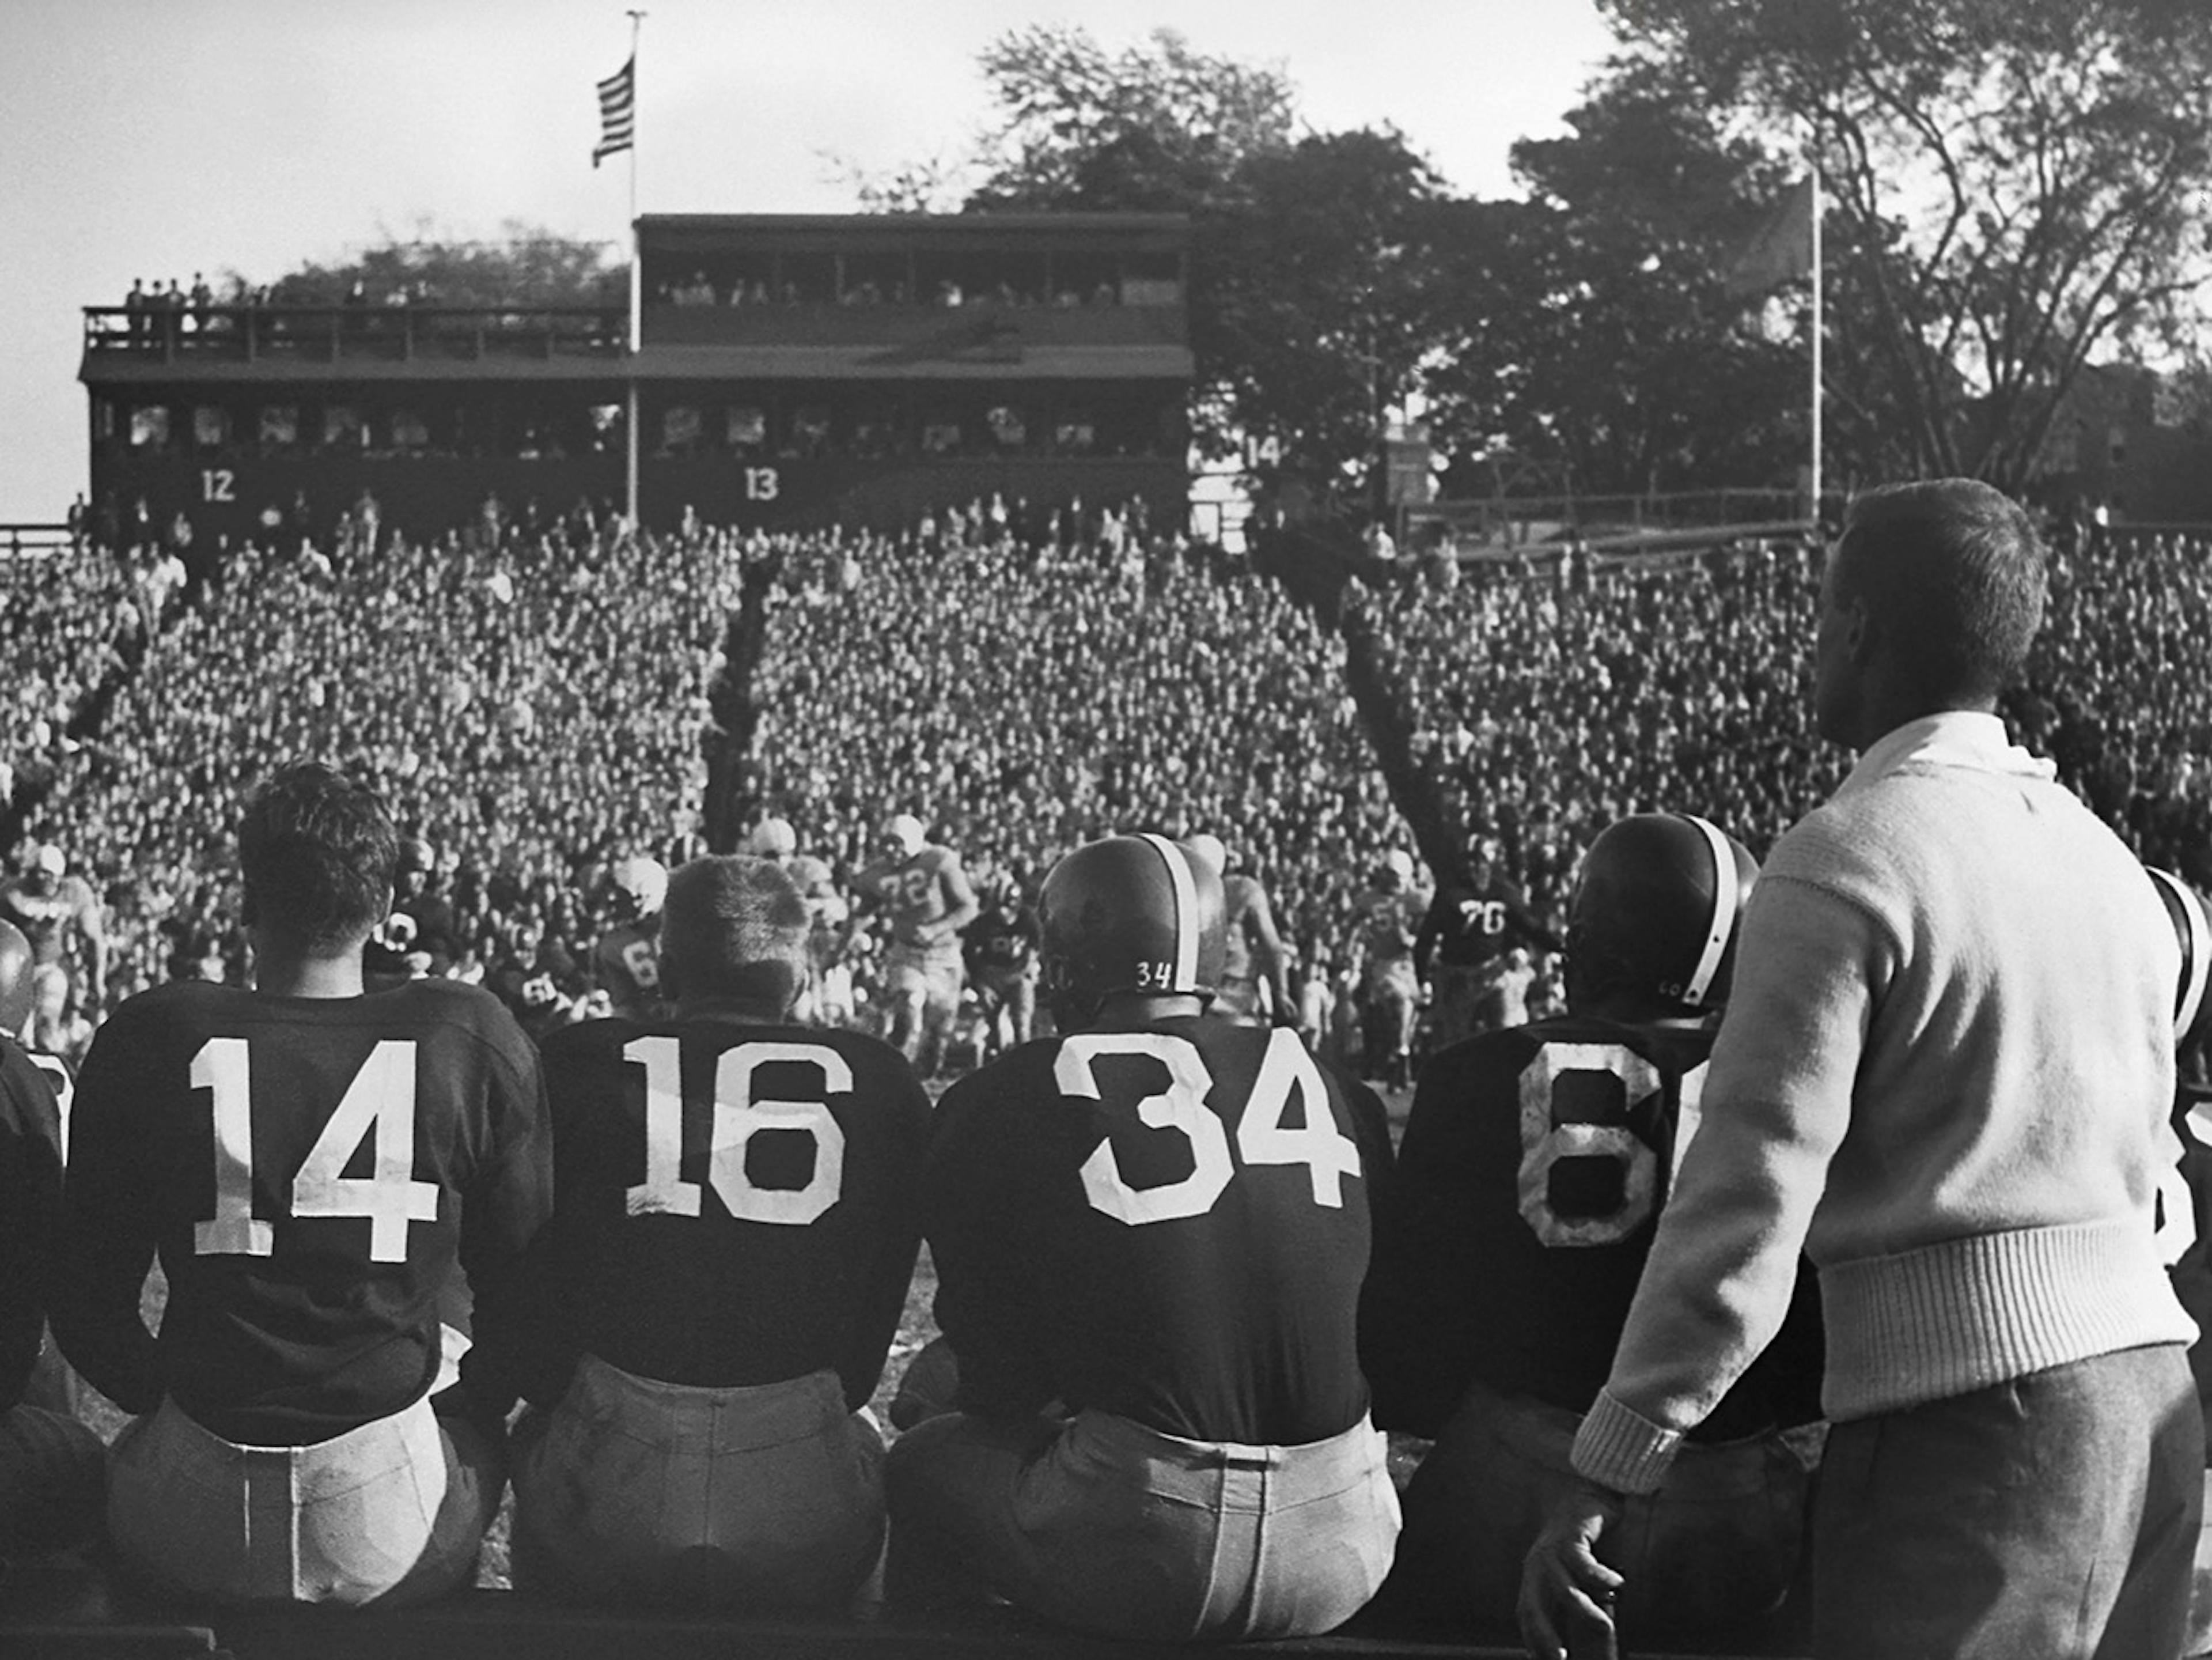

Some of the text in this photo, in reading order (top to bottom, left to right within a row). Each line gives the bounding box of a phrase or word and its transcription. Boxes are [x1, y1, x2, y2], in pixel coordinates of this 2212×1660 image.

[1247, 434, 1281, 468] 14
[202, 470, 236, 502] 12
[745, 467, 778, 501] 13
[1137, 961, 1172, 989] 34
[623, 1035, 854, 1225] 16
[1054, 1027, 1362, 1226] 34
[190, 1037, 440, 1263] 14
